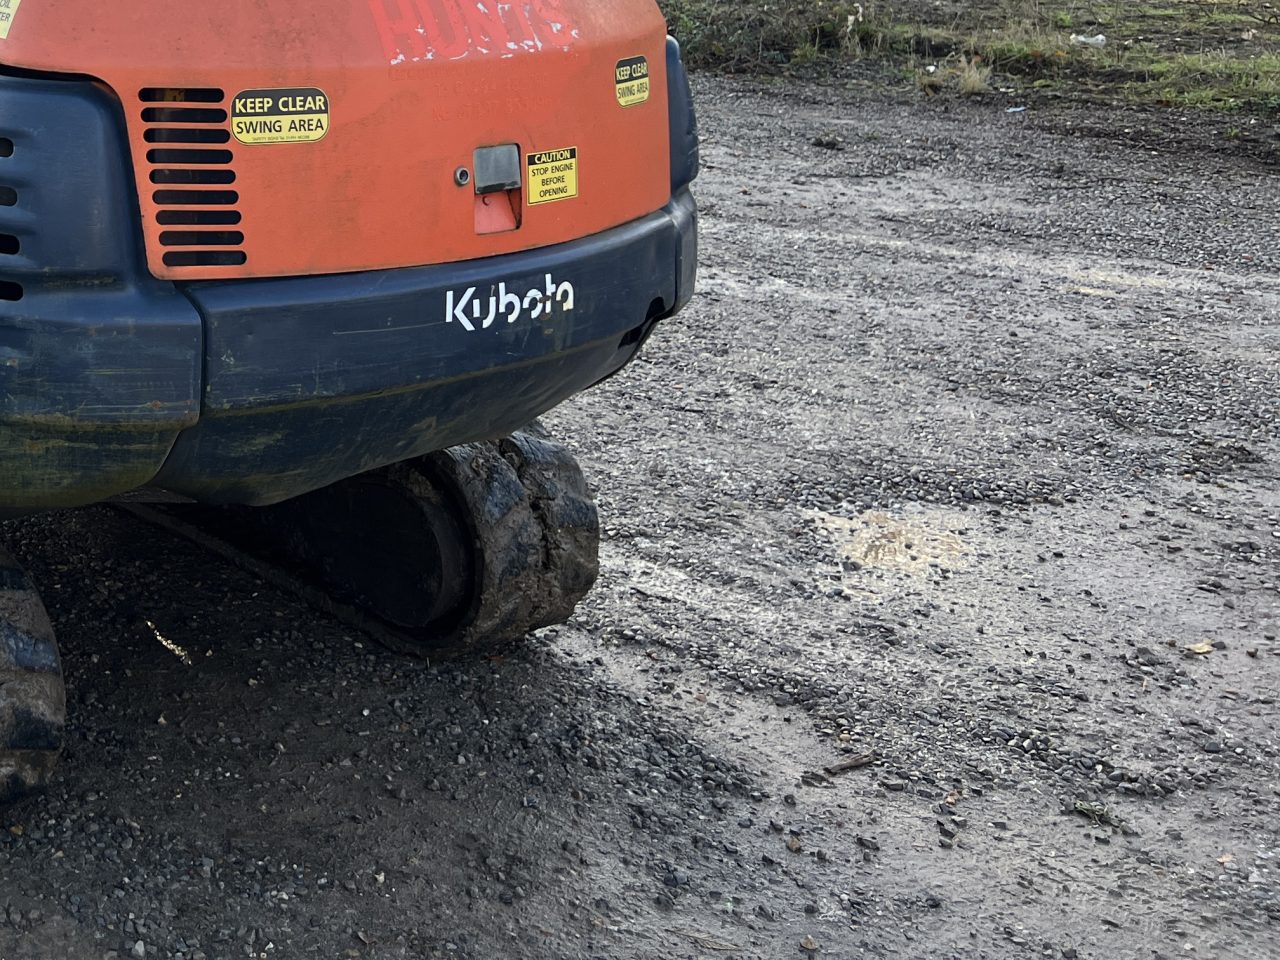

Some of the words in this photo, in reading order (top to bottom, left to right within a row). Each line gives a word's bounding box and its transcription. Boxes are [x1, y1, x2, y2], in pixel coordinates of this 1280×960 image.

[616, 66, 631, 81] KEEP
[631, 62, 648, 77] CLEAR
[617, 85, 636, 99] SWING
[636, 81, 649, 95] AREA
[235, 97, 273, 113] KEEP
[278, 96, 326, 112] CLEAR
[236, 120, 282, 134] SWING
[288, 118, 324, 132] AREA
[534, 150, 571, 164] CAUTION
[531, 167, 549, 177] STOP
[550, 163, 574, 174] ENGINE
[541, 175, 566, 186] BEFORE
[539, 186, 568, 197] OPENING
[445, 273, 575, 332] Kubota
